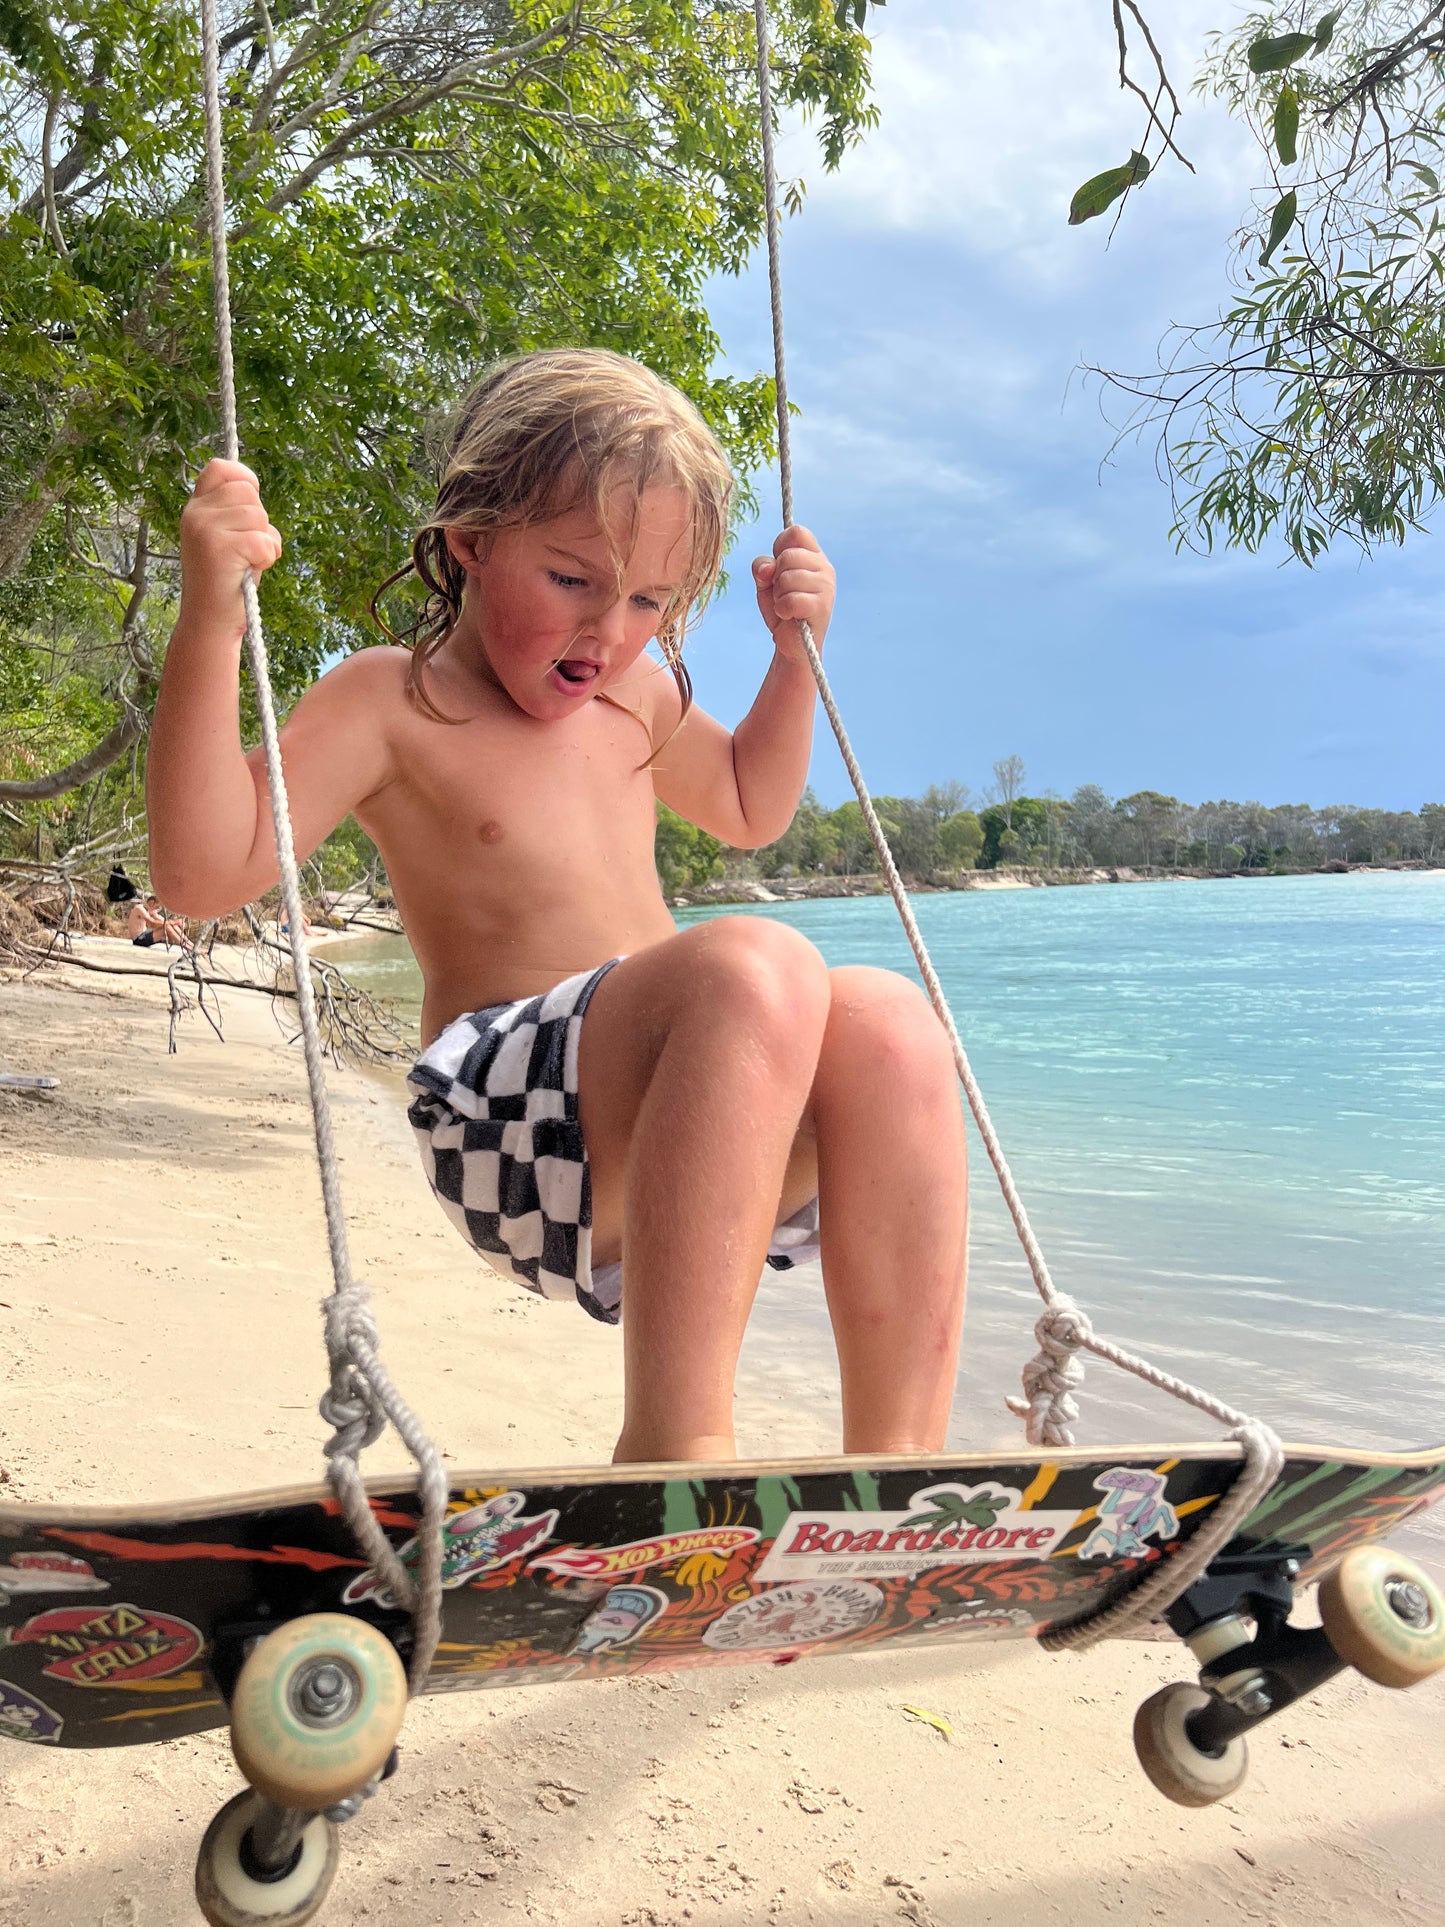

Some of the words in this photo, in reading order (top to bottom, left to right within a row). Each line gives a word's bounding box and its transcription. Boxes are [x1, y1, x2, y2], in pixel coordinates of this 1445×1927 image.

[784, 1521, 1057, 1553] Boardstore
[600, 1543, 661, 1573] HOT
[71, 1628, 173, 1683] CRUZ
